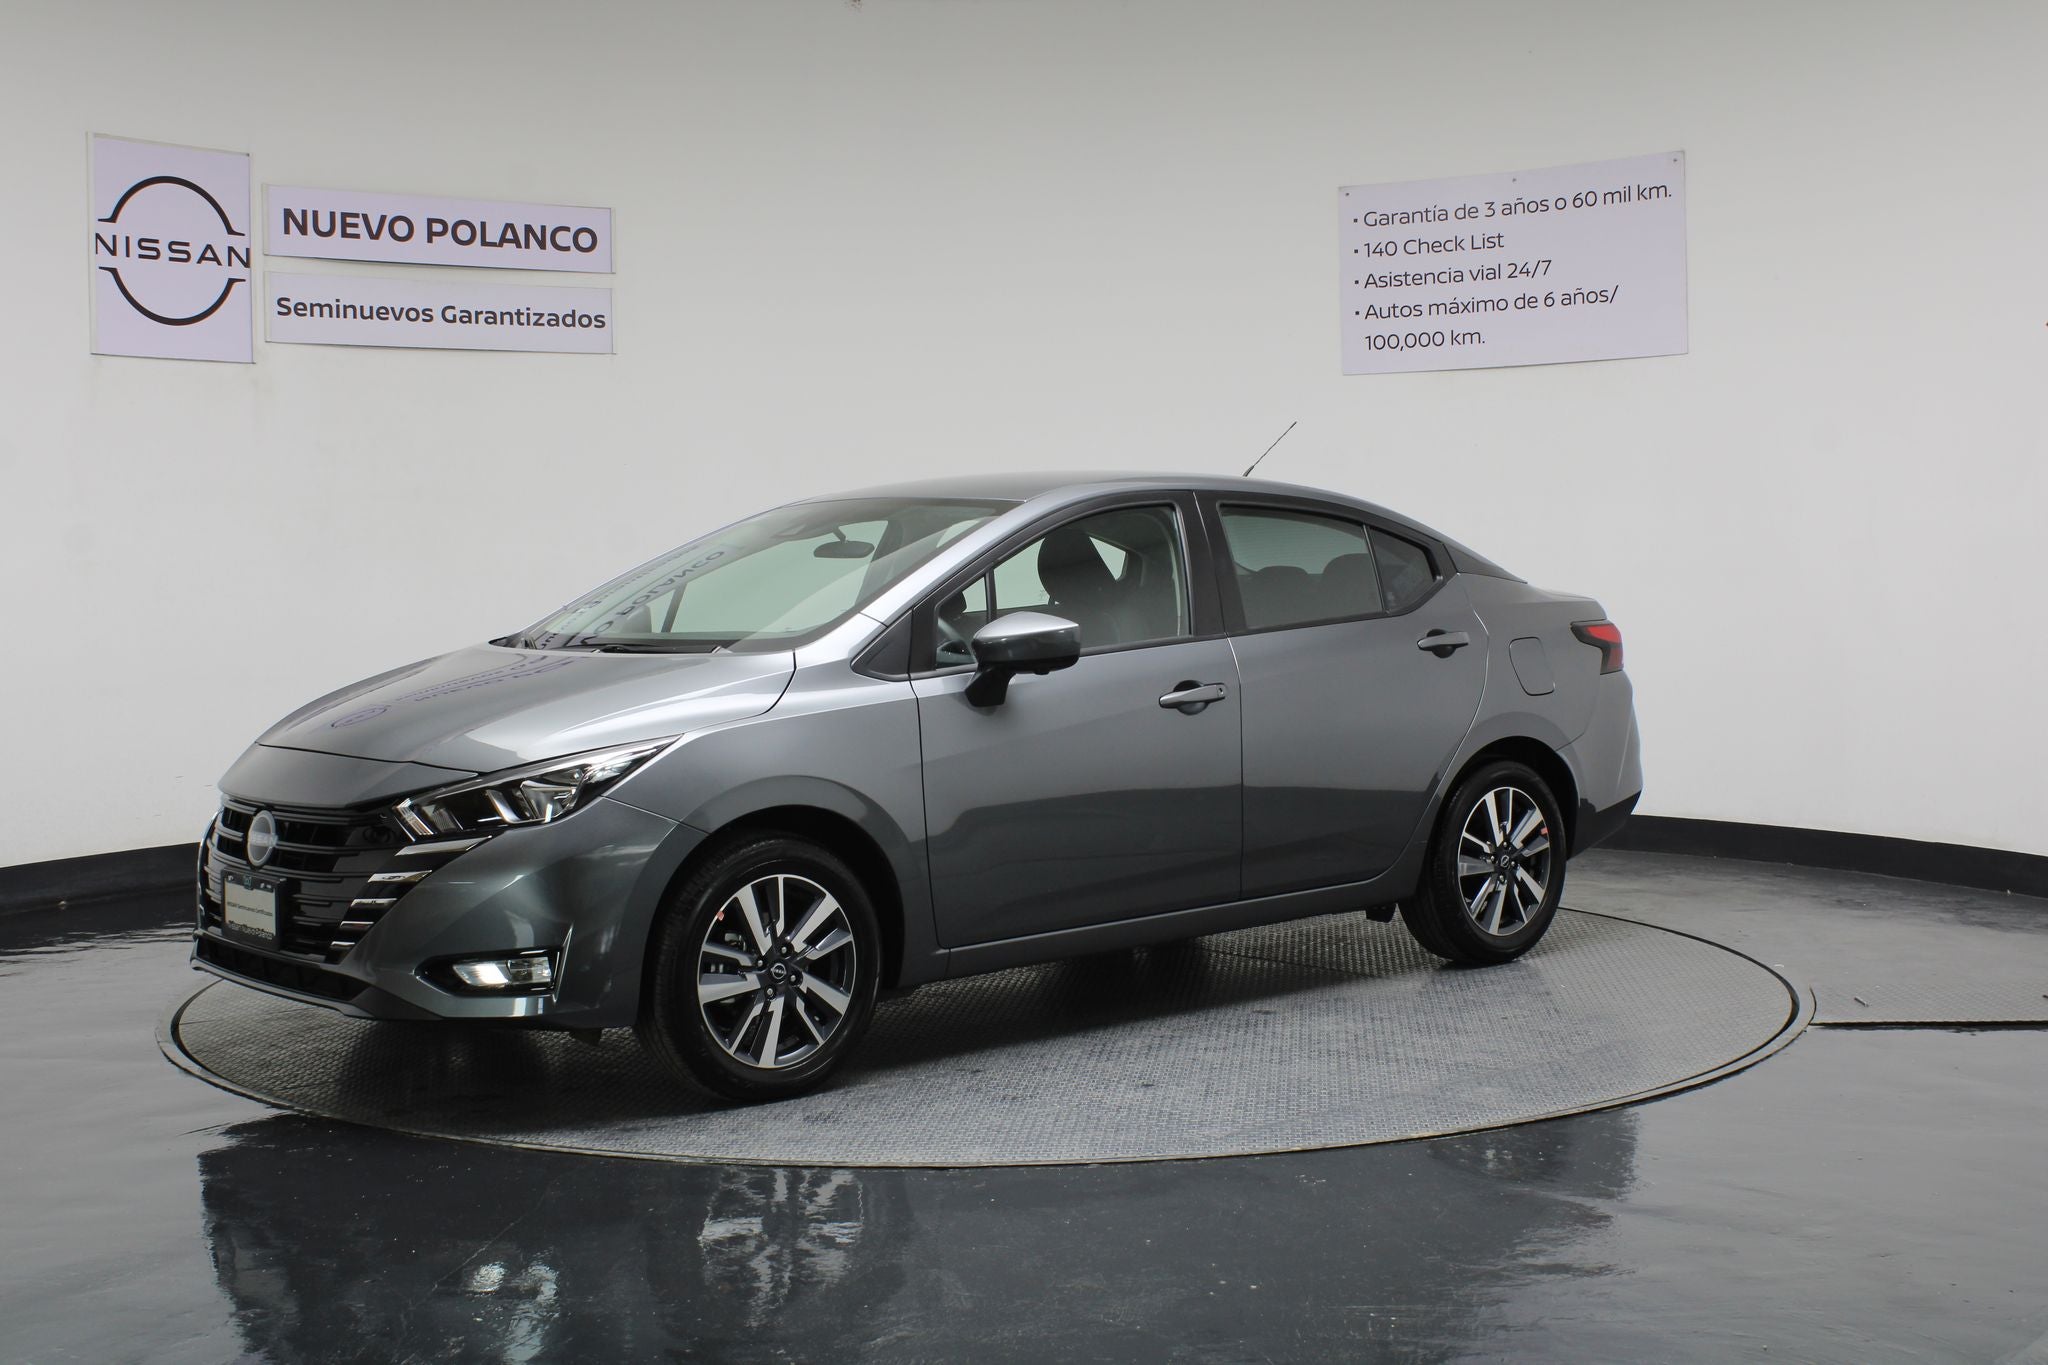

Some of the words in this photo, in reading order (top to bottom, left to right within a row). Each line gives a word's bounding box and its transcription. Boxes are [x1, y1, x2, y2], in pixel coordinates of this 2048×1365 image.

[1363, 204, 1449, 228] Garantía
[1454, 202, 1480, 221] de
[1484, 201, 1496, 218] 3
[1501, 196, 1550, 217] años
[1554, 197, 1568, 211] o
[1572, 190, 1598, 209] 60
[1602, 184, 1632, 206] mil
[1636, 183, 1673, 203] km.
[282, 208, 415, 243] NUEVO
[427, 218, 599, 254] POLANCO
[1363, 240, 1398, 258] 140
[1403, 234, 1466, 256] Check
[1470, 232, 1505, 251] List
[95, 232, 250, 269] NISSAN
[1363, 266, 1464, 289] Asistencia
[1468, 263, 1502, 283] vial
[1506, 259, 1553, 279] 24/7
[276, 296, 435, 324] Seminuevos
[441, 304, 607, 329] Garantizados
[1364, 303, 1424, 321] Autos
[1428, 296, 1509, 317] máximo
[1513, 292, 1539, 310] de
[1543, 291, 1556, 308] 6
[1560, 284, 1620, 307] años/
[1364, 331, 1446, 352] 100,000
[1450, 329, 1486, 347] km.
